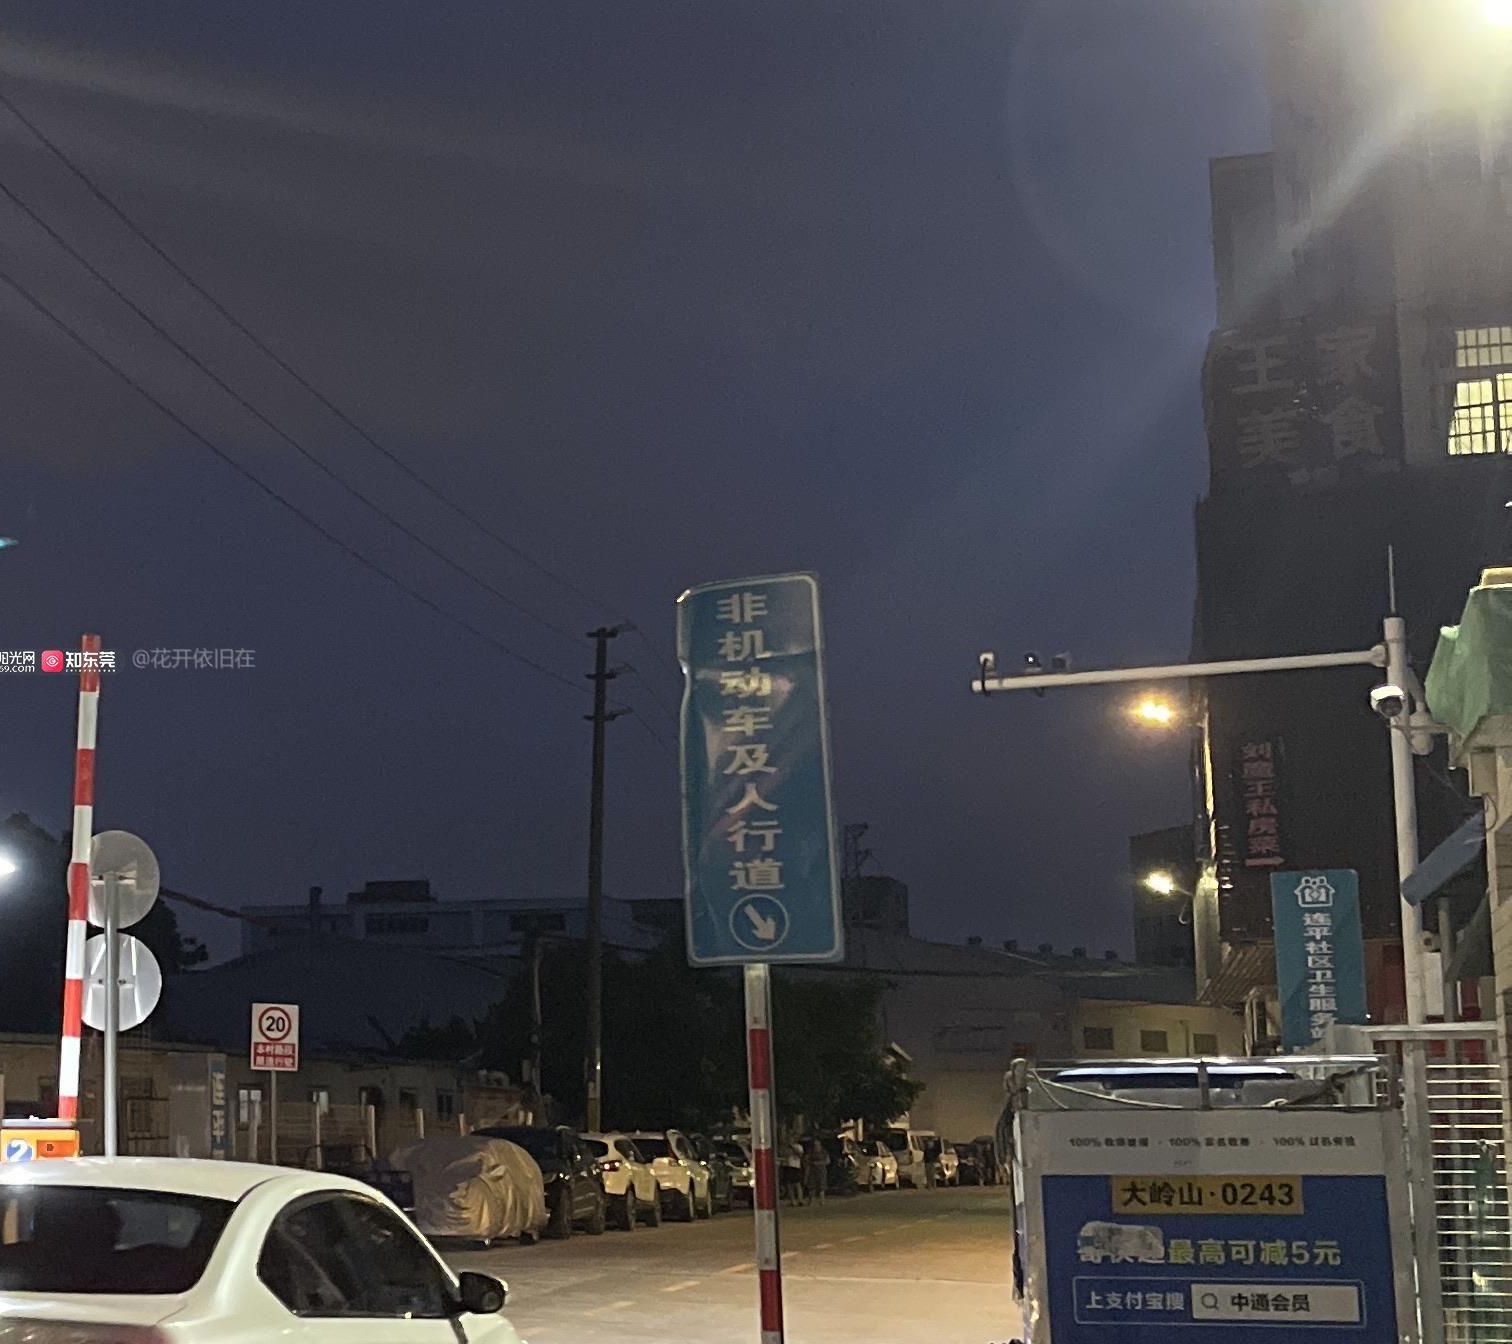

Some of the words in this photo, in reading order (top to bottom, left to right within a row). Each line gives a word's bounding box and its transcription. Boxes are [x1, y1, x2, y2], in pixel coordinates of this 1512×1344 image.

[716, 592, 784, 891] 非机动车及人行道
[266, 1016, 285, 1032] 20
[8, 1139, 30, 1162] 2
[1121, 1181, 1295, 1208] 大岭山·0243
[1086, 1291, 1185, 1311] 上支付宝搜
[1231, 1293, 1311, 1313] 中通会员
